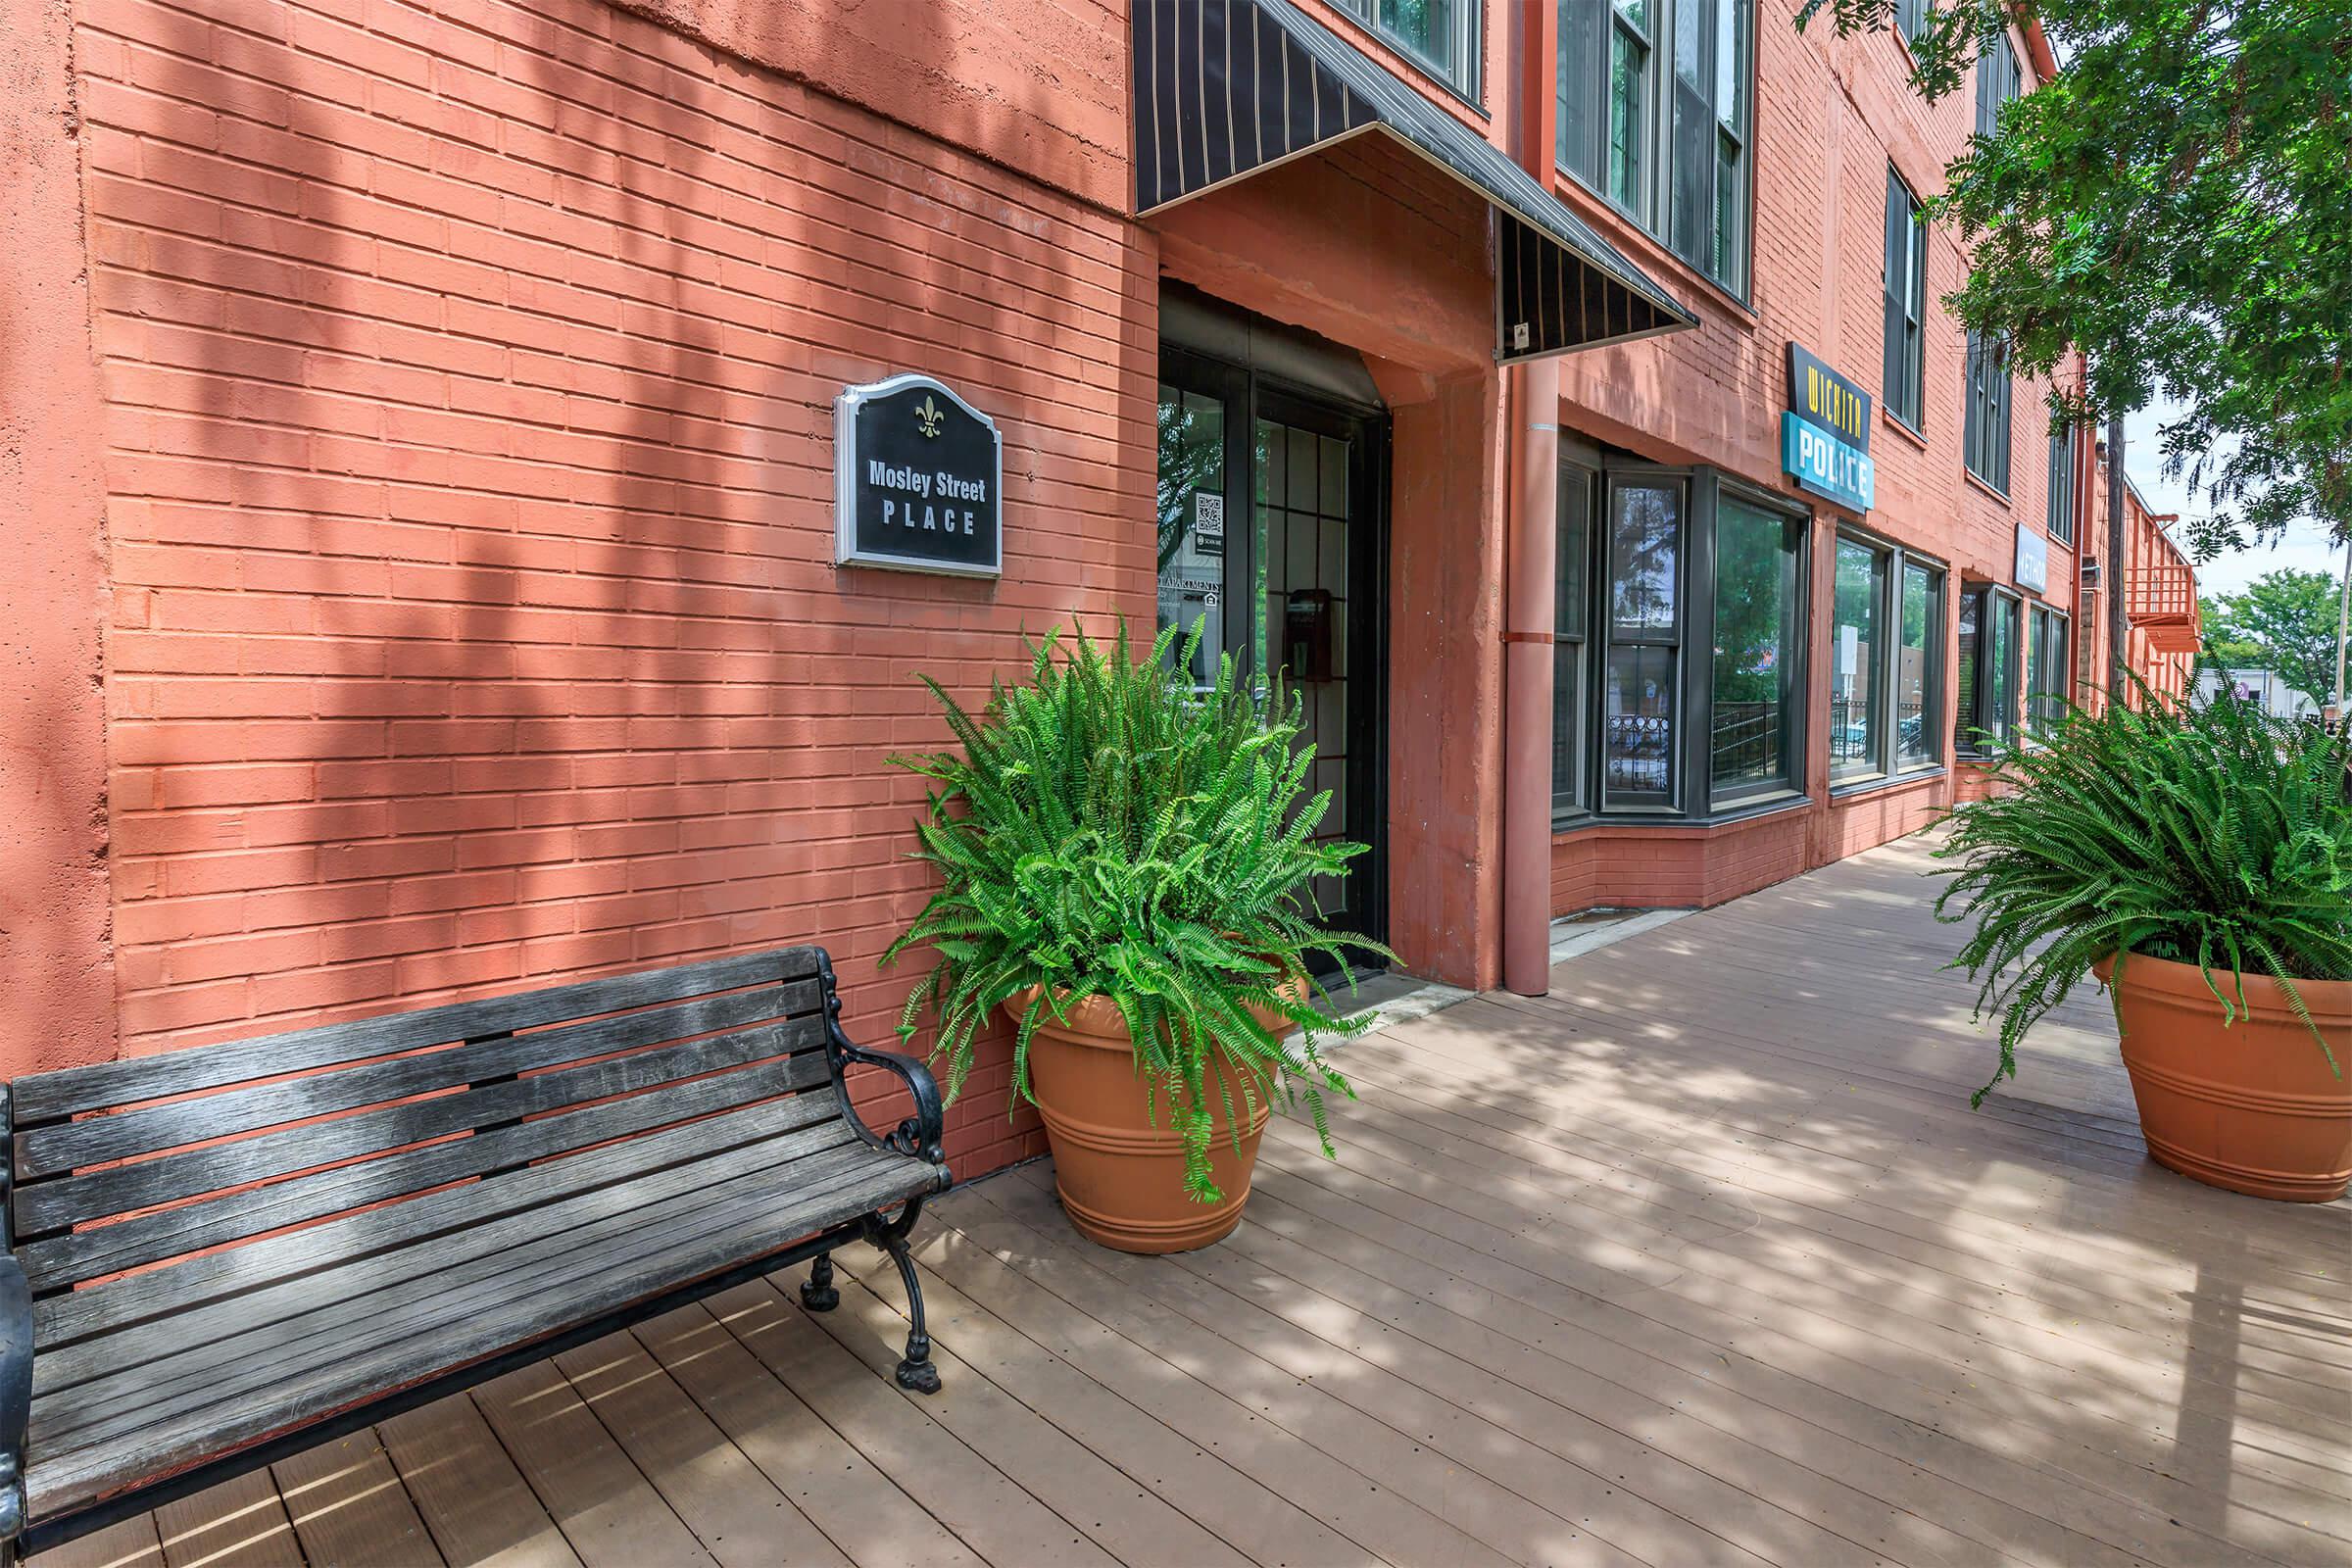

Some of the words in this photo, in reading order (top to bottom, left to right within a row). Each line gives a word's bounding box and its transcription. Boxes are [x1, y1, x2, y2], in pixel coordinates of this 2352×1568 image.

[1807, 366, 1861, 439] WICHITA
[869, 460, 932, 498] Mosley
[936, 471, 986, 503] Street
[1799, 428, 1868, 498] POLICE
[883, 500, 974, 535] PLACE
[1166, 577, 1219, 592] APARTMENTS
